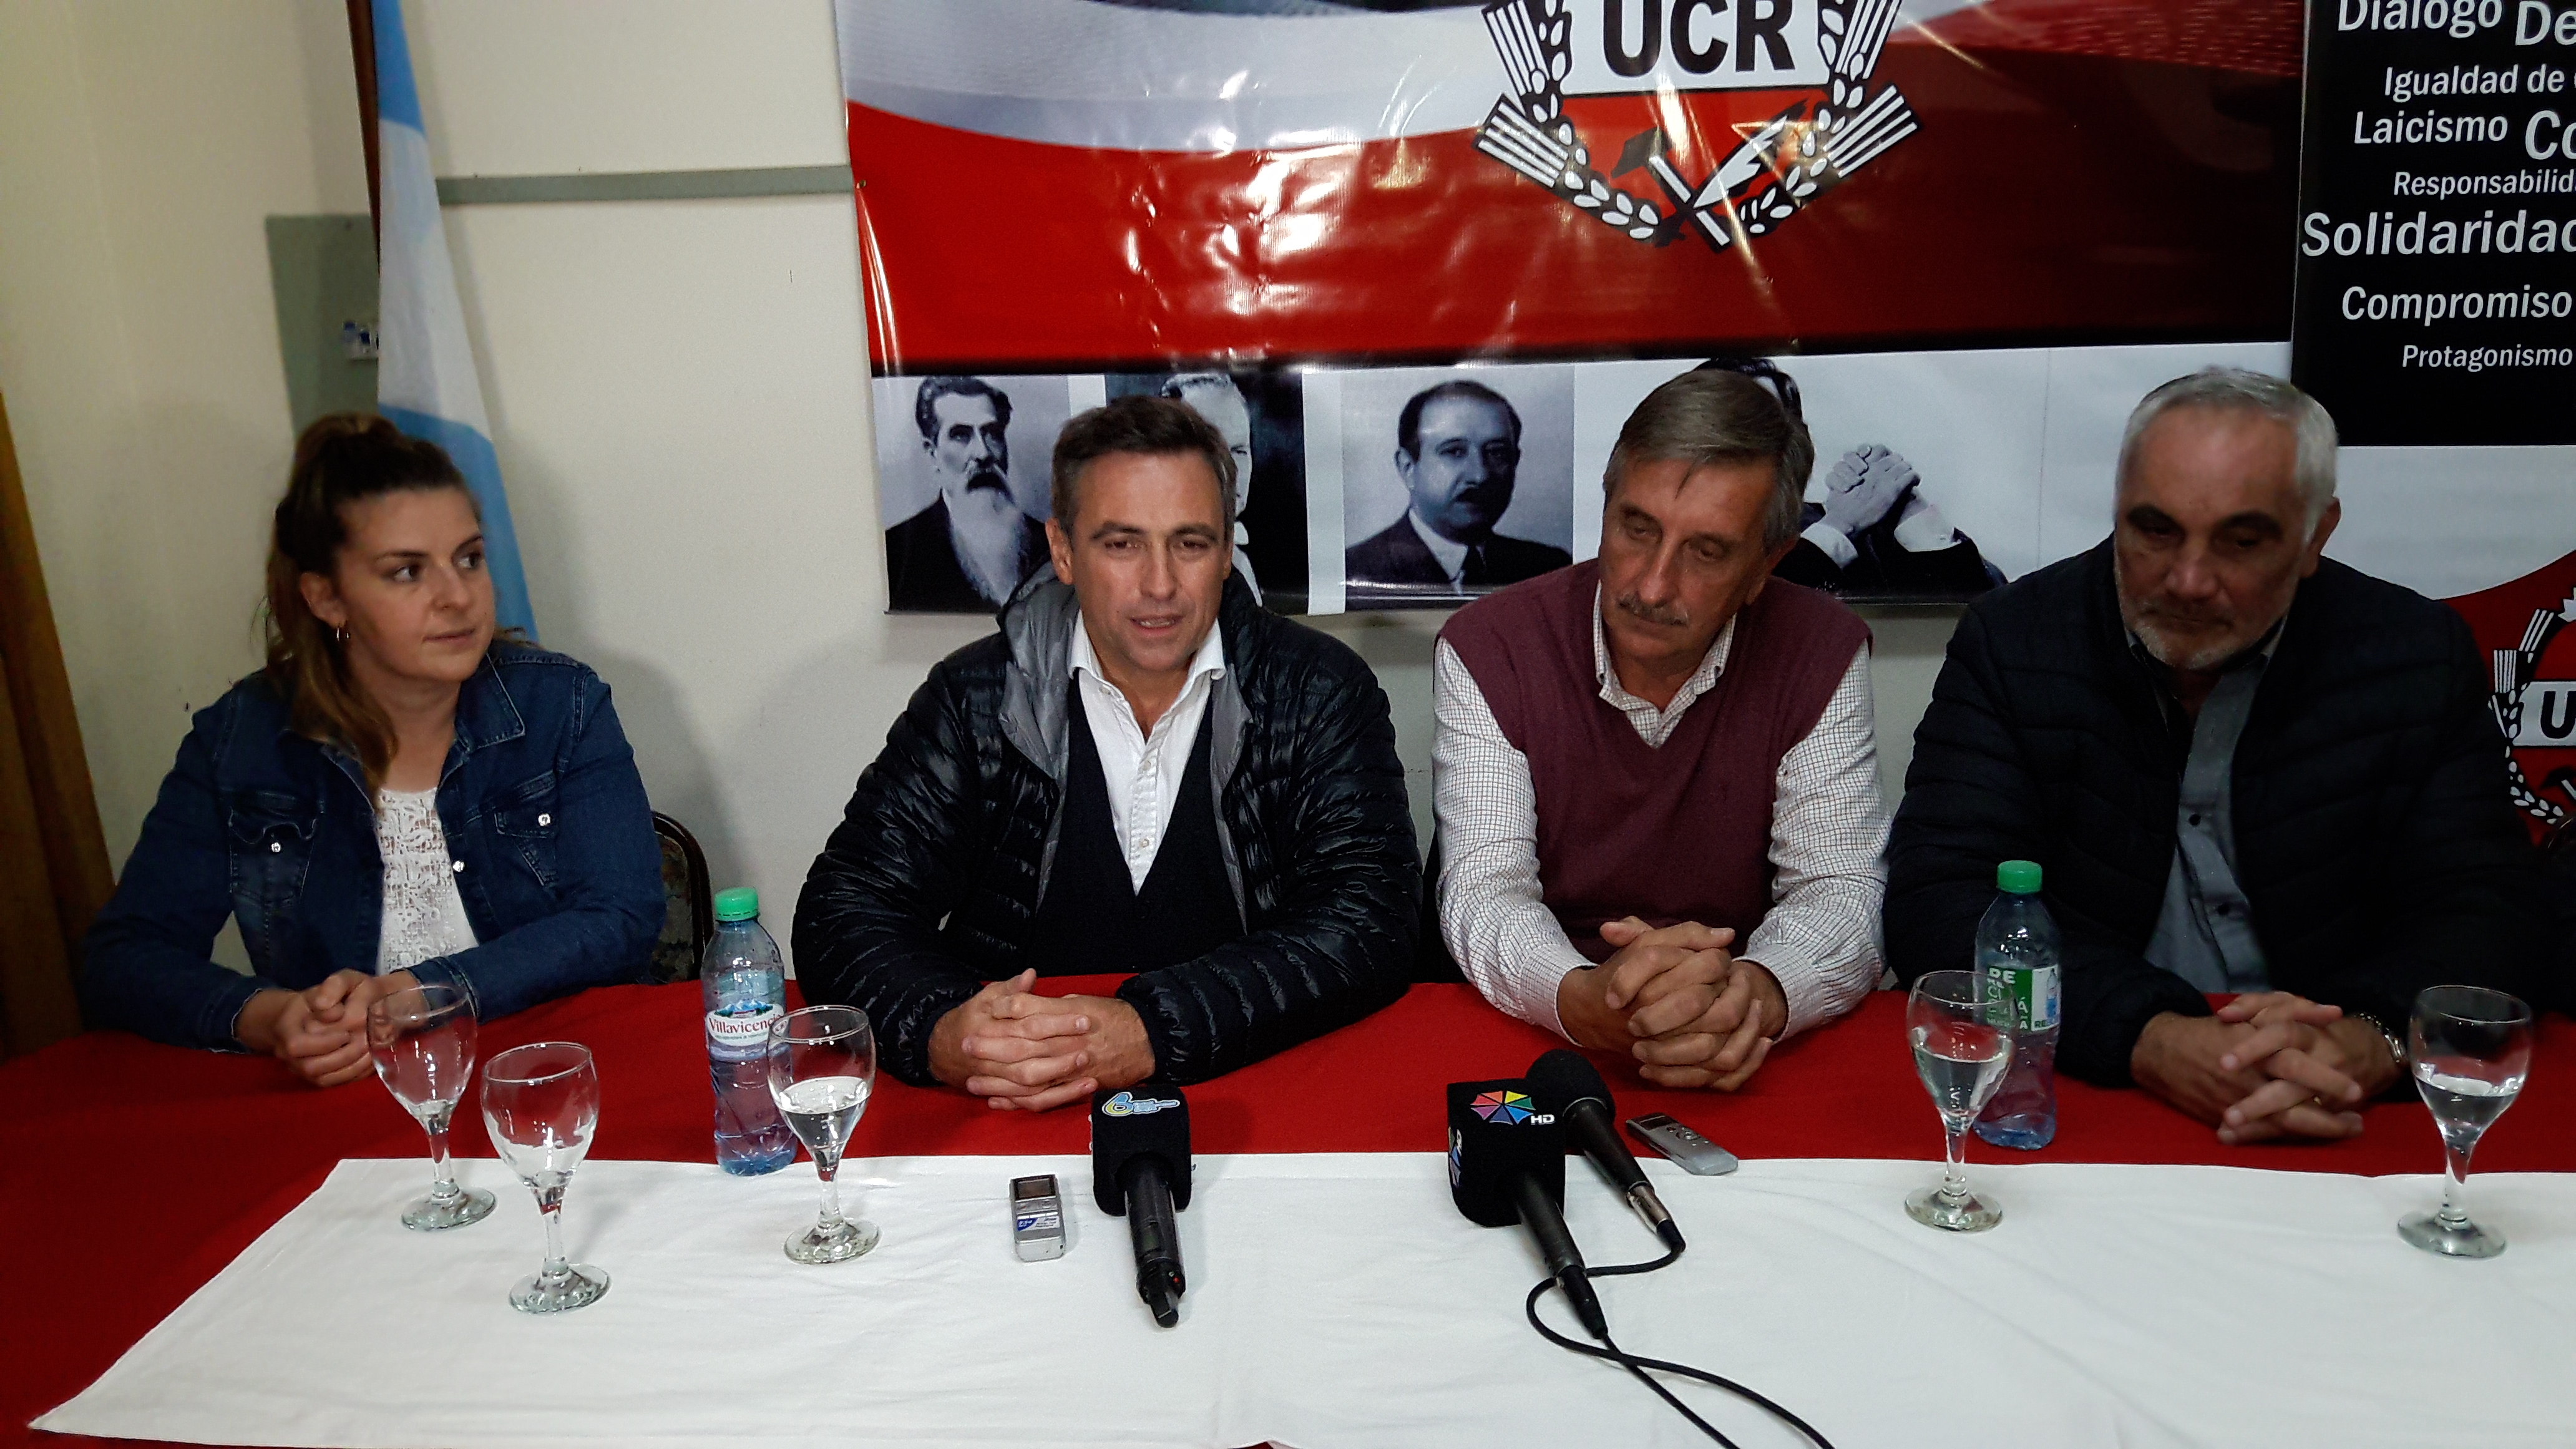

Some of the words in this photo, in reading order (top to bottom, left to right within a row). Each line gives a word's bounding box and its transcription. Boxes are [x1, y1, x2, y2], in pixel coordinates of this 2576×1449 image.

[1604, 0, 1795, 77] UCR
[2384, 64, 2519, 103] Igualdad
[2527, 64, 2565, 94] de
[2354, 110, 2508, 144] Laicismo
[2342, 285, 2572, 326] Compromiso
[2402, 344, 2573, 373] Protagonismo
[1989, 968, 2016, 984] DE
[1530, 1114, 1555, 1126] HD
